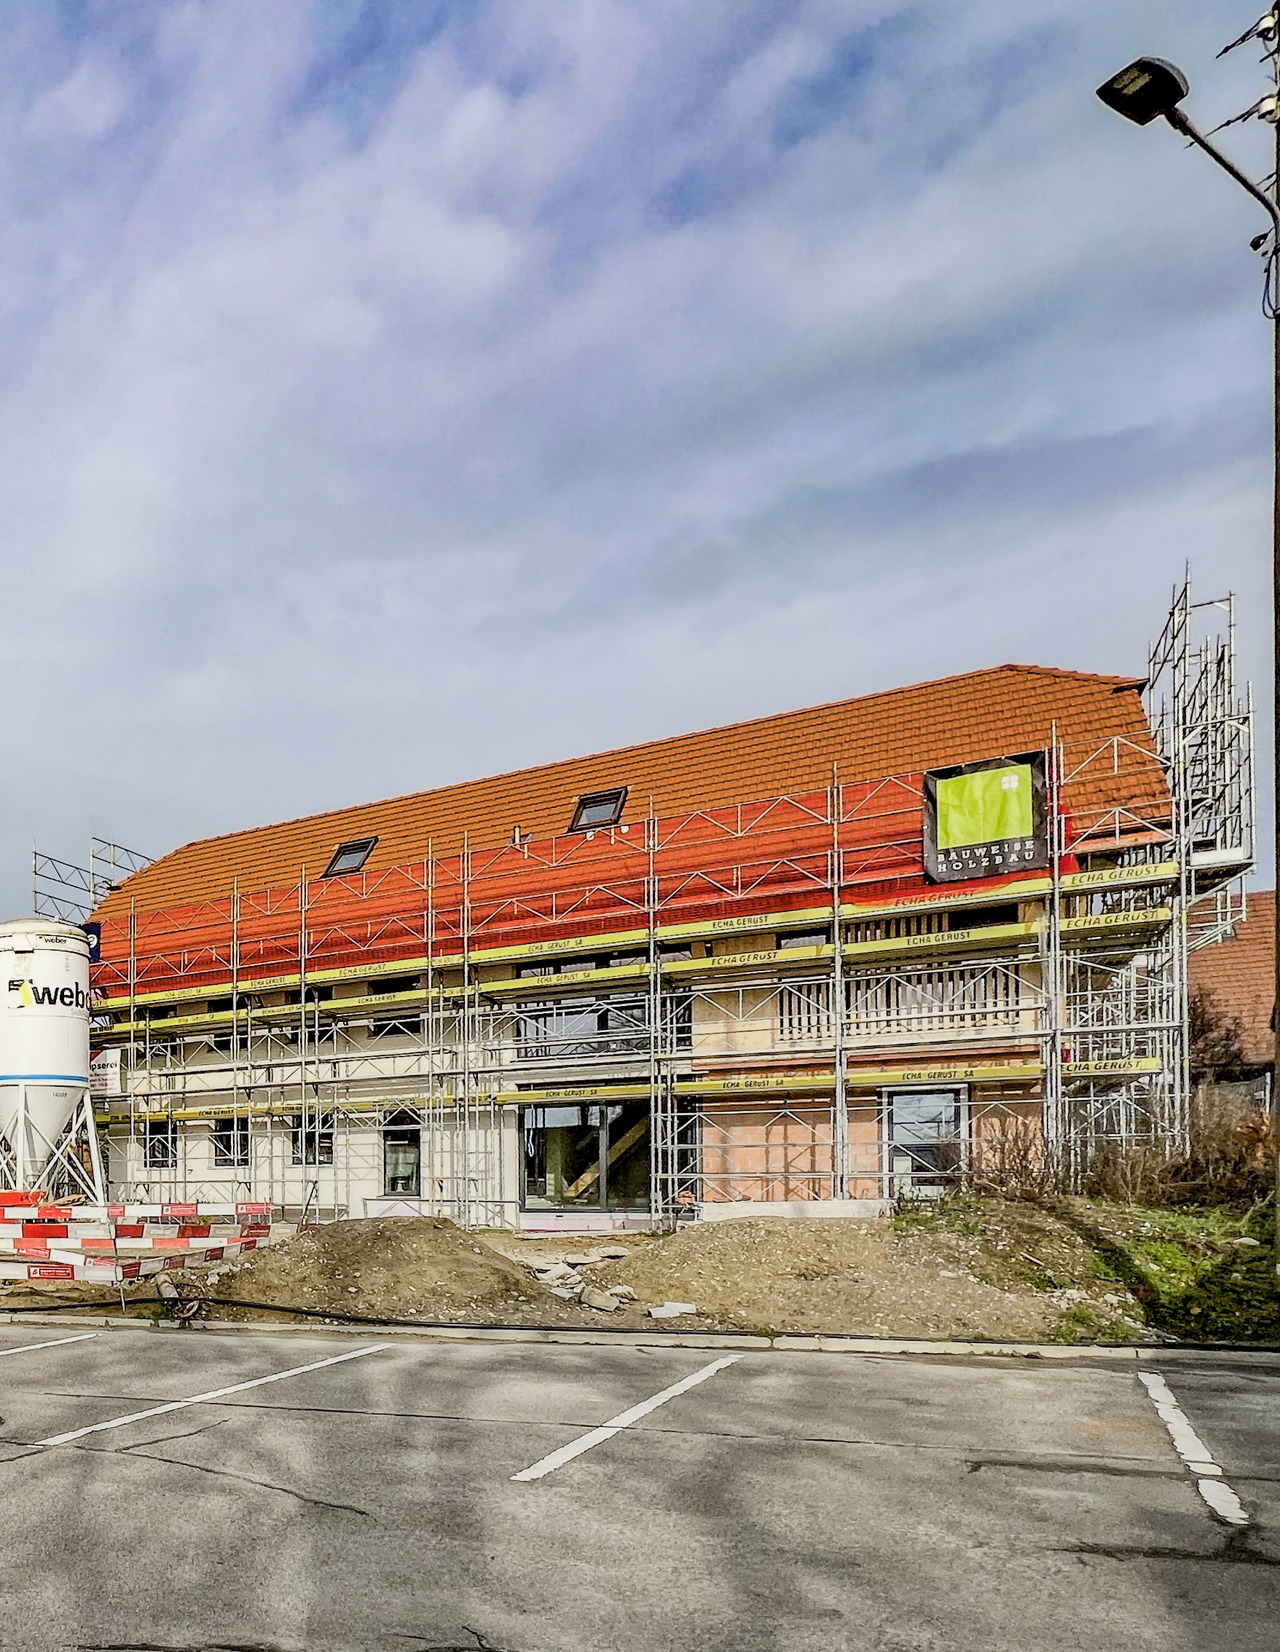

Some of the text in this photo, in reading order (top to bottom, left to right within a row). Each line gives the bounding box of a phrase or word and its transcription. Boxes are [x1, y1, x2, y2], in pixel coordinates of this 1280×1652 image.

[937, 840, 1035, 862] BAUWEISE
[937, 851, 1035, 873] HOLZBAU
[1071, 872, 1104, 885] ECHA
[712, 920, 734, 929] ECHA
[1066, 915, 1101, 928] ECHA
[45, 934, 67, 944] weber
[907, 936, 932, 946] ECHA
[711, 954, 737, 966] ECHA
[902, 1072, 922, 1080] ECHA
